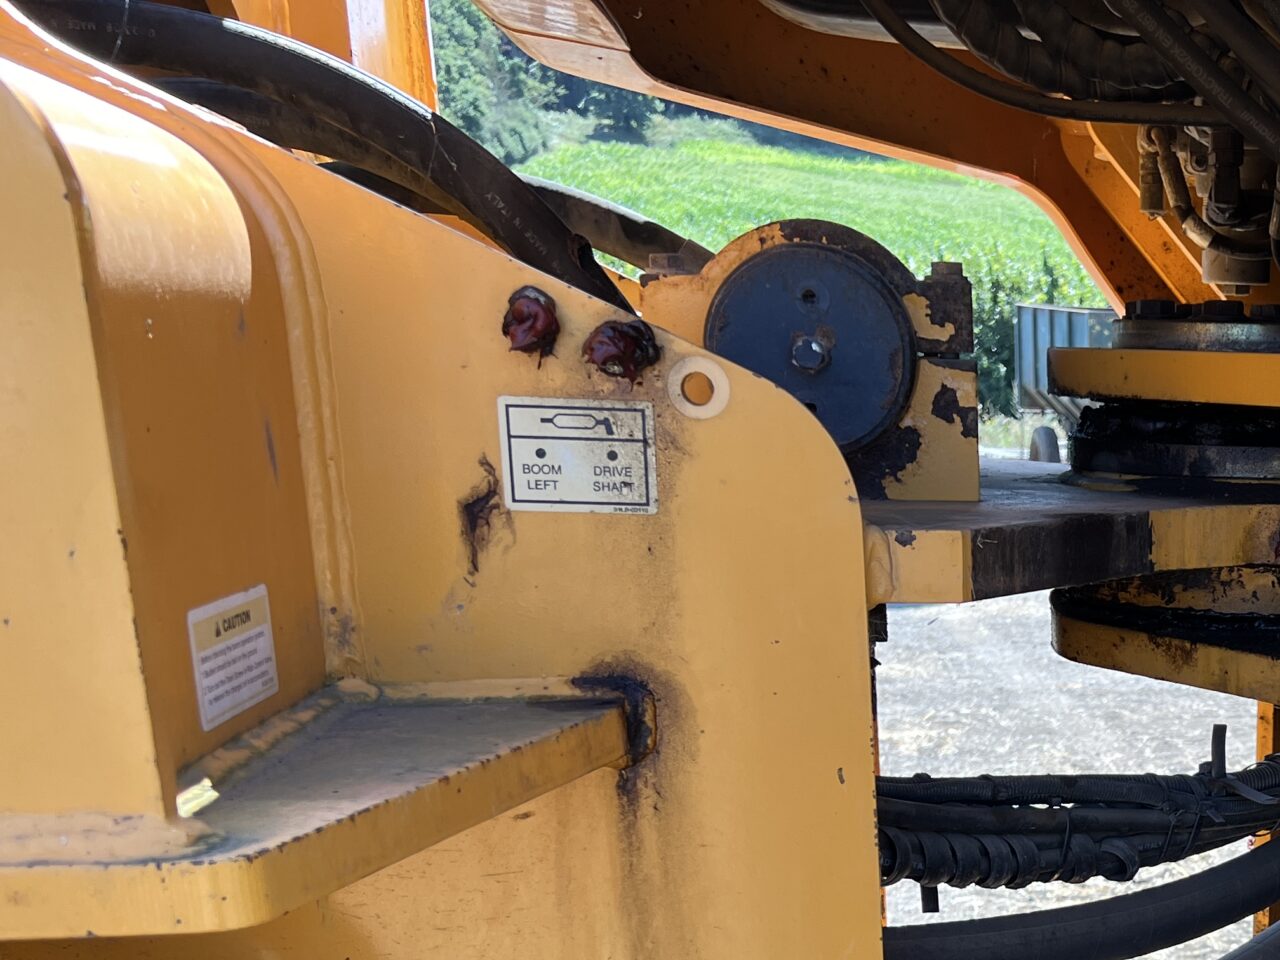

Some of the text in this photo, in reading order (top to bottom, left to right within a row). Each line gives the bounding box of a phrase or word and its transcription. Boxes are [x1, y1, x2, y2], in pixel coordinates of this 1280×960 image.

[522, 464, 562, 475] BOOM
[594, 466, 632, 478] DRIVE
[527, 480, 559, 490] LEFT
[593, 481, 635, 492] SHAFT
[223, 609, 252, 633] CAUTION
